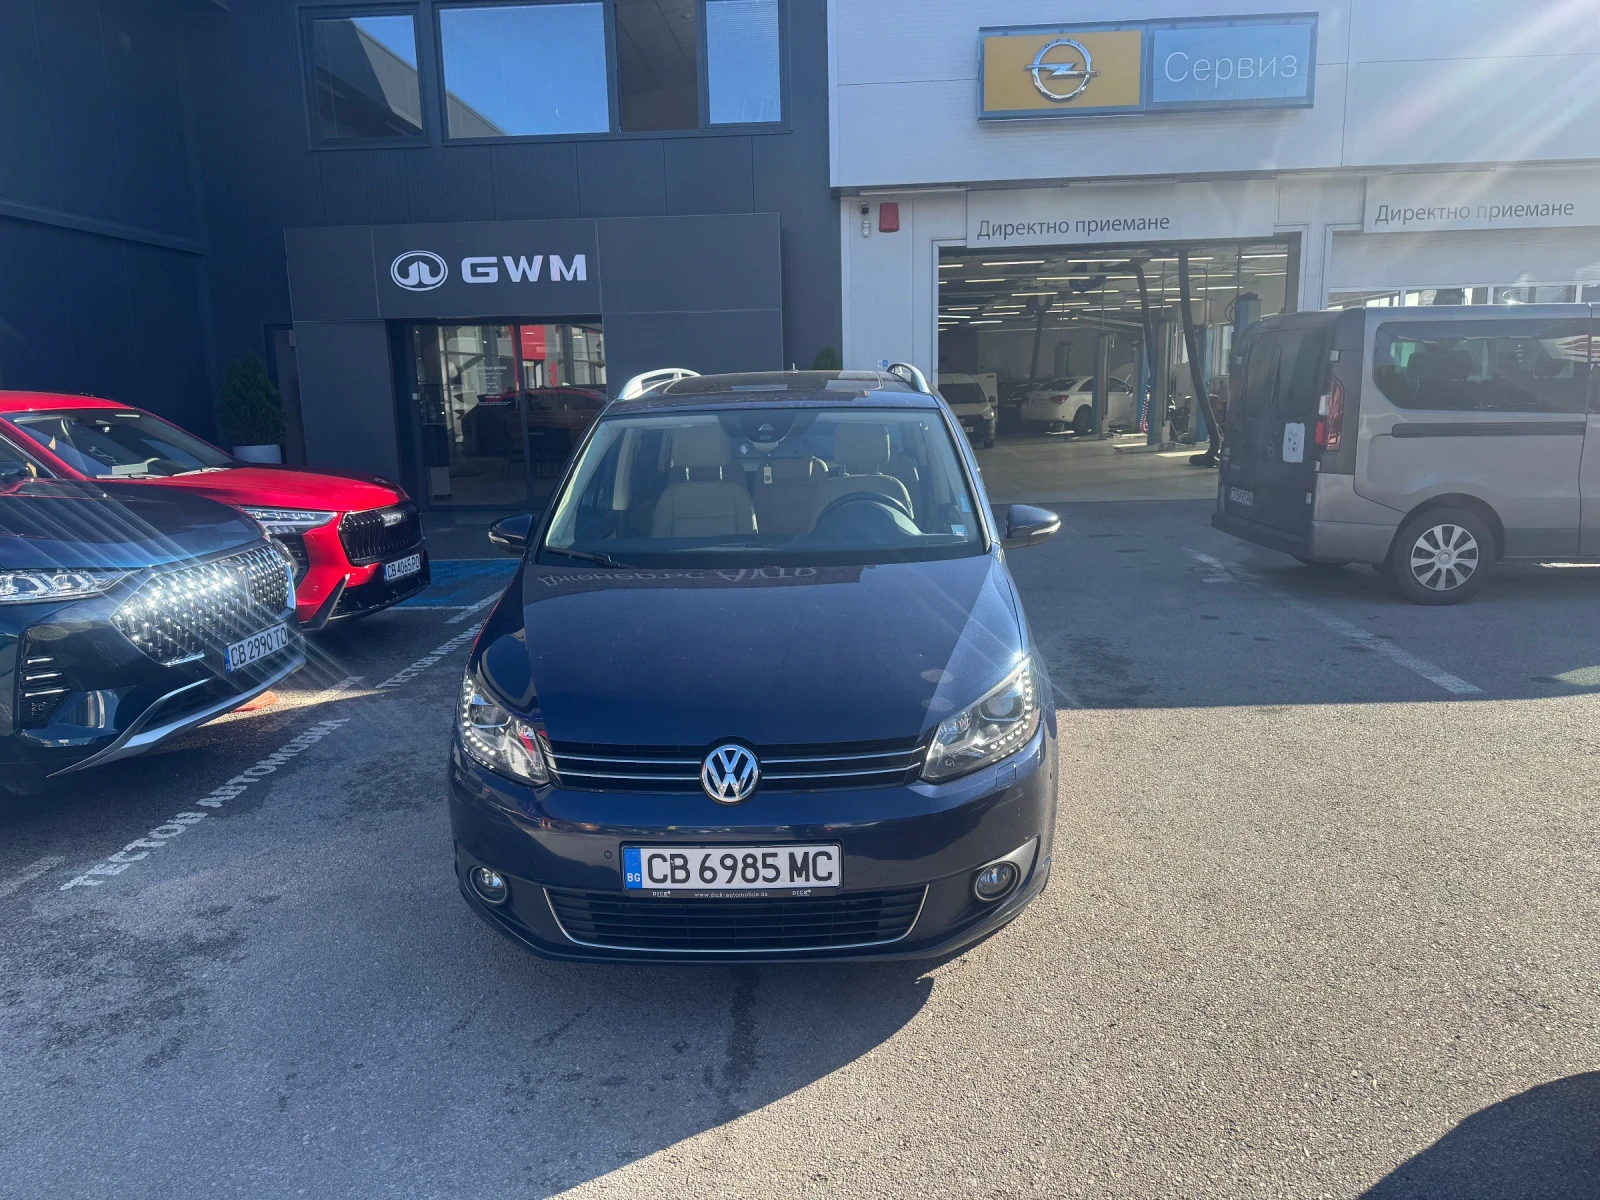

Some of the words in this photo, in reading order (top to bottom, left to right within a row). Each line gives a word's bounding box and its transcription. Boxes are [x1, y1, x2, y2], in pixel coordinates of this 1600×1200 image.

[1164, 51, 1298, 89] Сервиз
[977, 219, 1070, 241] Директно
[1075, 216, 1170, 237] приемане
[1375, 204, 1471, 225] Директно
[1476, 202, 1575, 223] приемане
[461, 254, 587, 284] GWM
[387, 563, 397, 578] CB
[230, 643, 247, 667] CB
[247, 632, 273, 660] 2990
[273, 626, 287, 648] TO
[59, 811, 209, 891] ТЕСТОВ
[195, 718, 350, 808] АВТОМОБИЛ
[627, 872, 641, 883] BG
[647, 853, 691, 885] CB
[698, 852, 781, 885] 6985
[788, 850, 833, 883] MC
